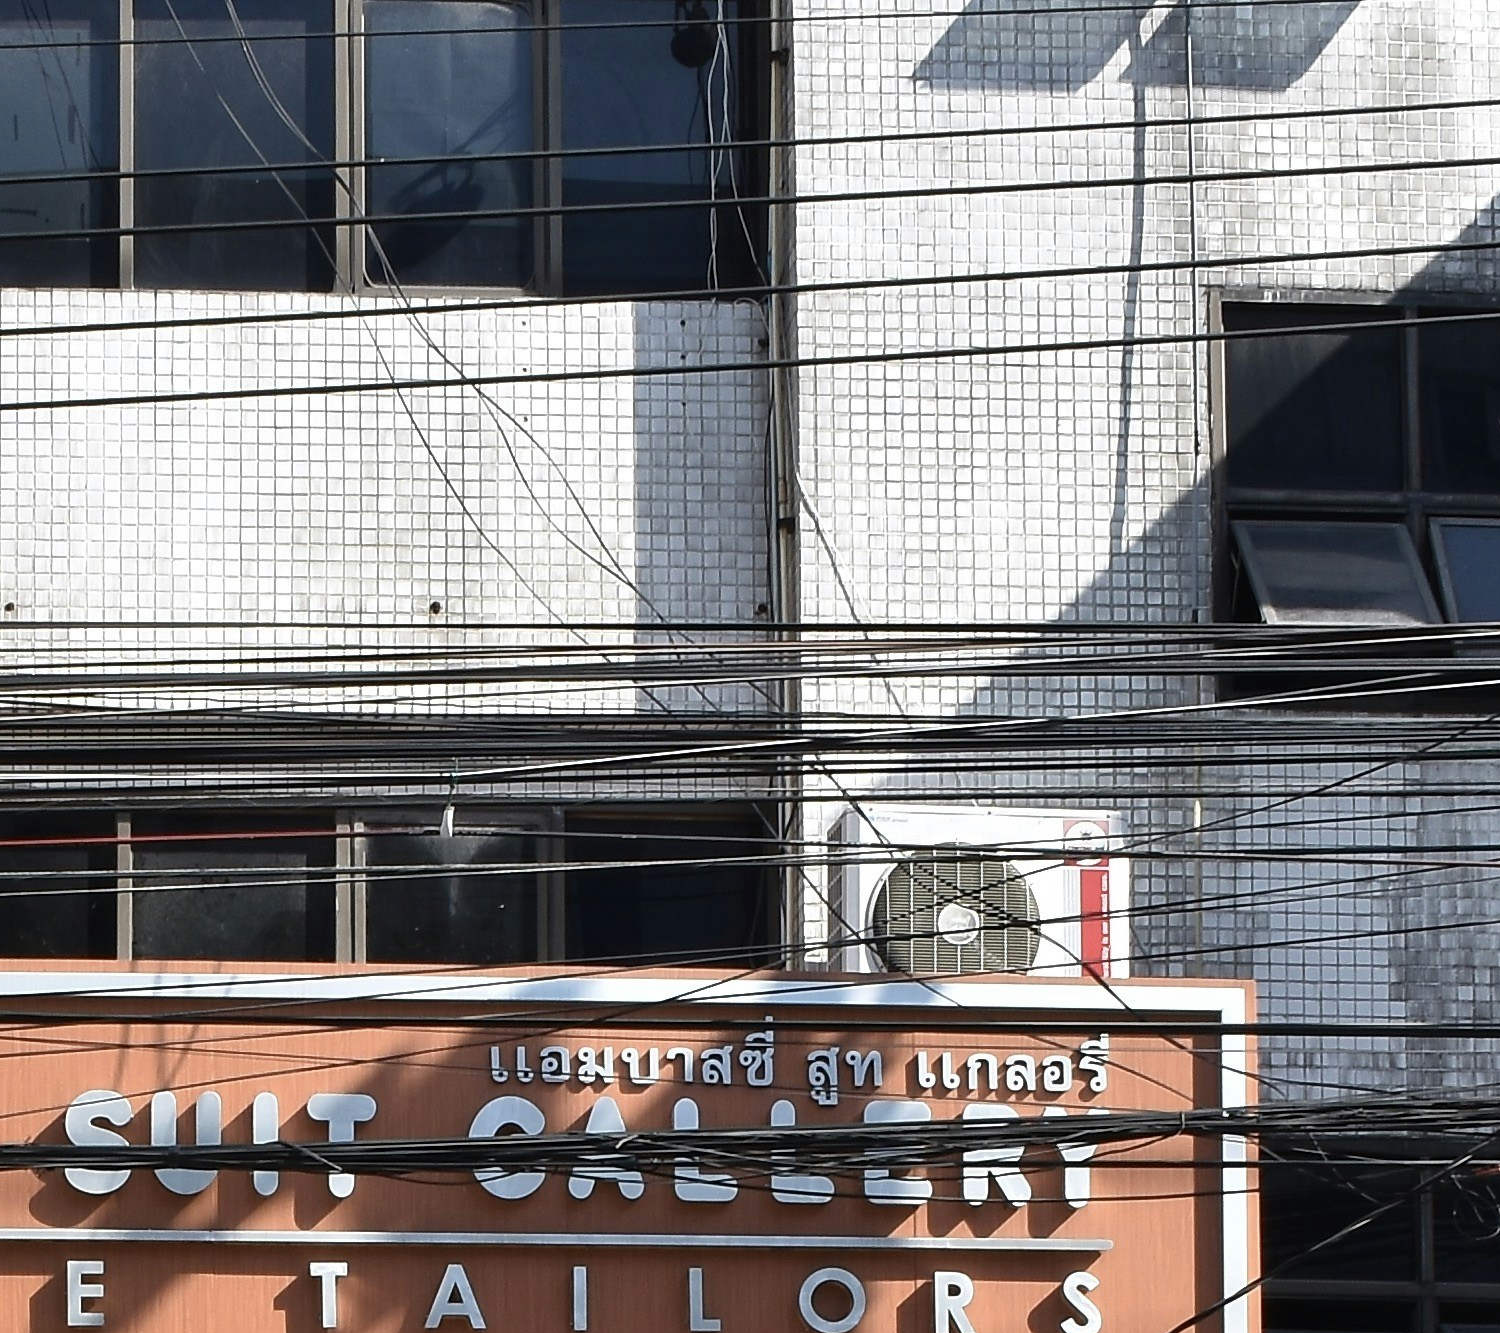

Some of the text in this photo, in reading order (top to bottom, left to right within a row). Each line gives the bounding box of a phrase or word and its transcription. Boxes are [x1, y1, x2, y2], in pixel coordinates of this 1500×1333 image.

[807, 1044, 883, 1106] สูท
[917, 1033, 1111, 1093] แกลอรี่
[64, 1089, 377, 1198] SUIT
